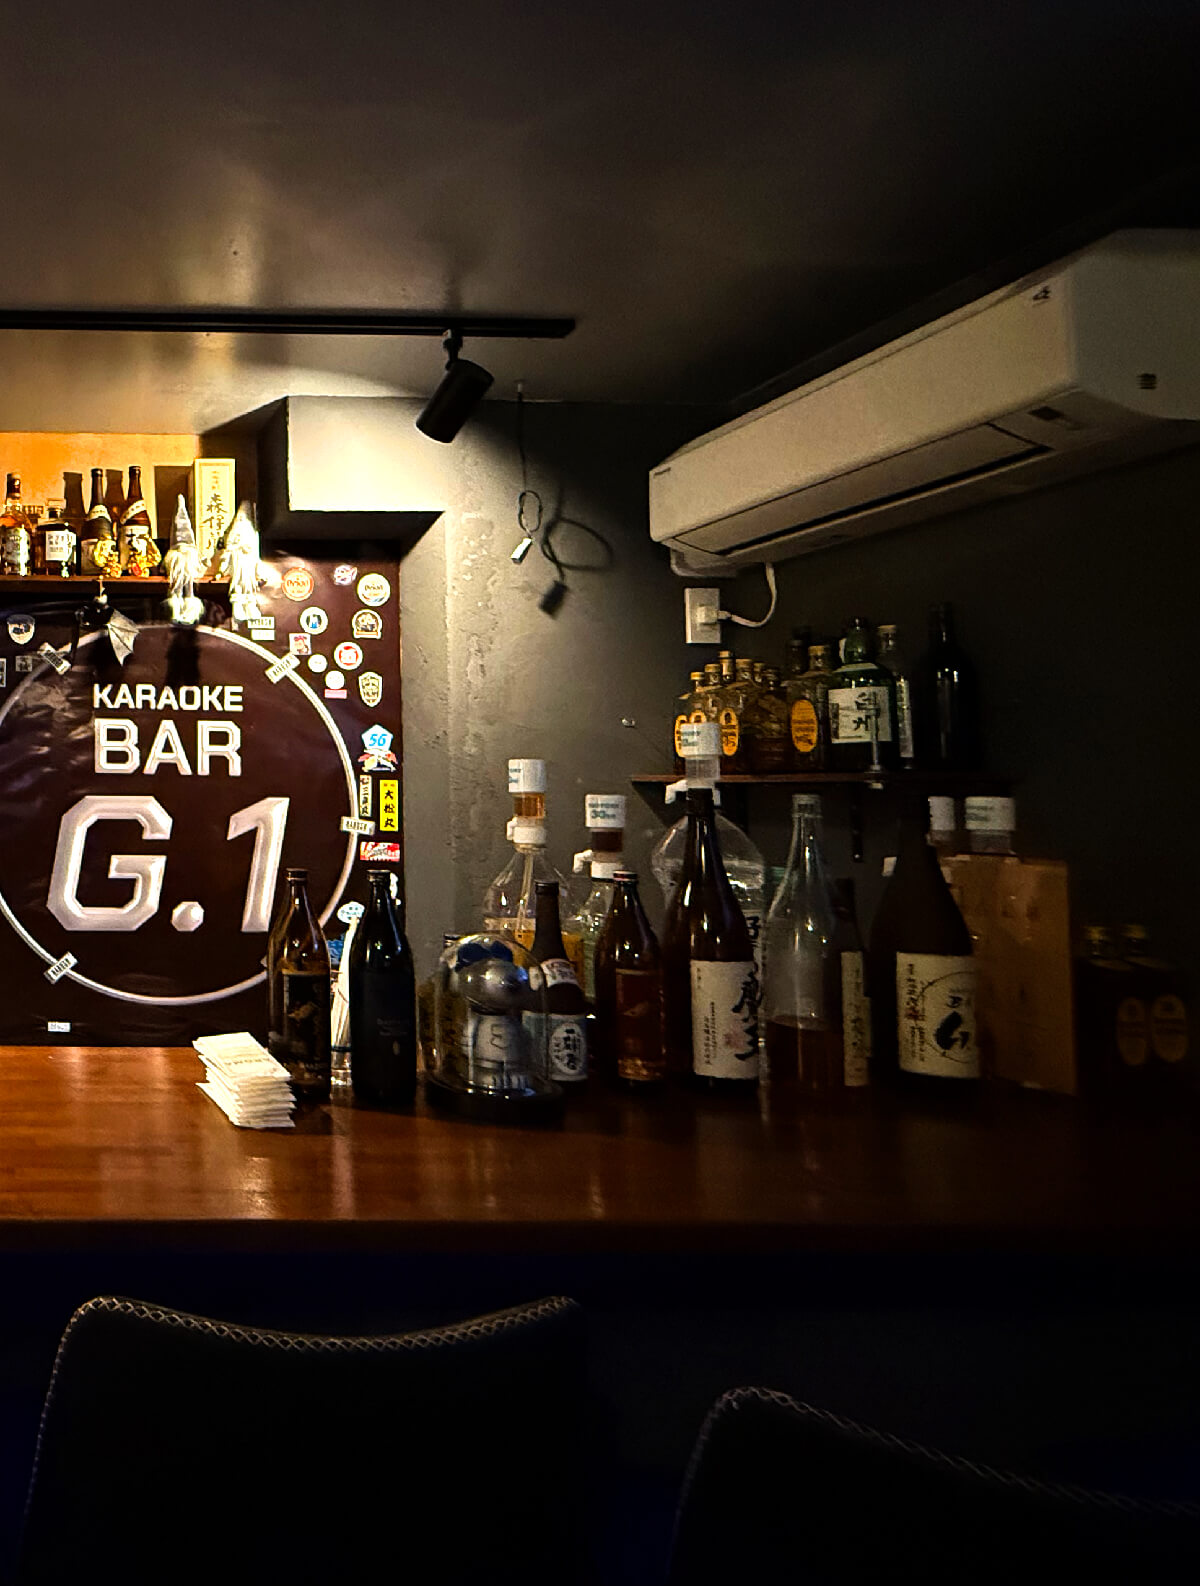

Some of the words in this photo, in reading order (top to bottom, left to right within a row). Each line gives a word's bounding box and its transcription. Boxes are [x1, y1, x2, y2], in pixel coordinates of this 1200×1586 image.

[93, 684, 244, 711] KARAOKE
[94, 718, 242, 776] BAR
[368, 733, 388, 747] 56
[384, 789, 396, 828] 大松丸
[47, 795, 290, 932] G.1
